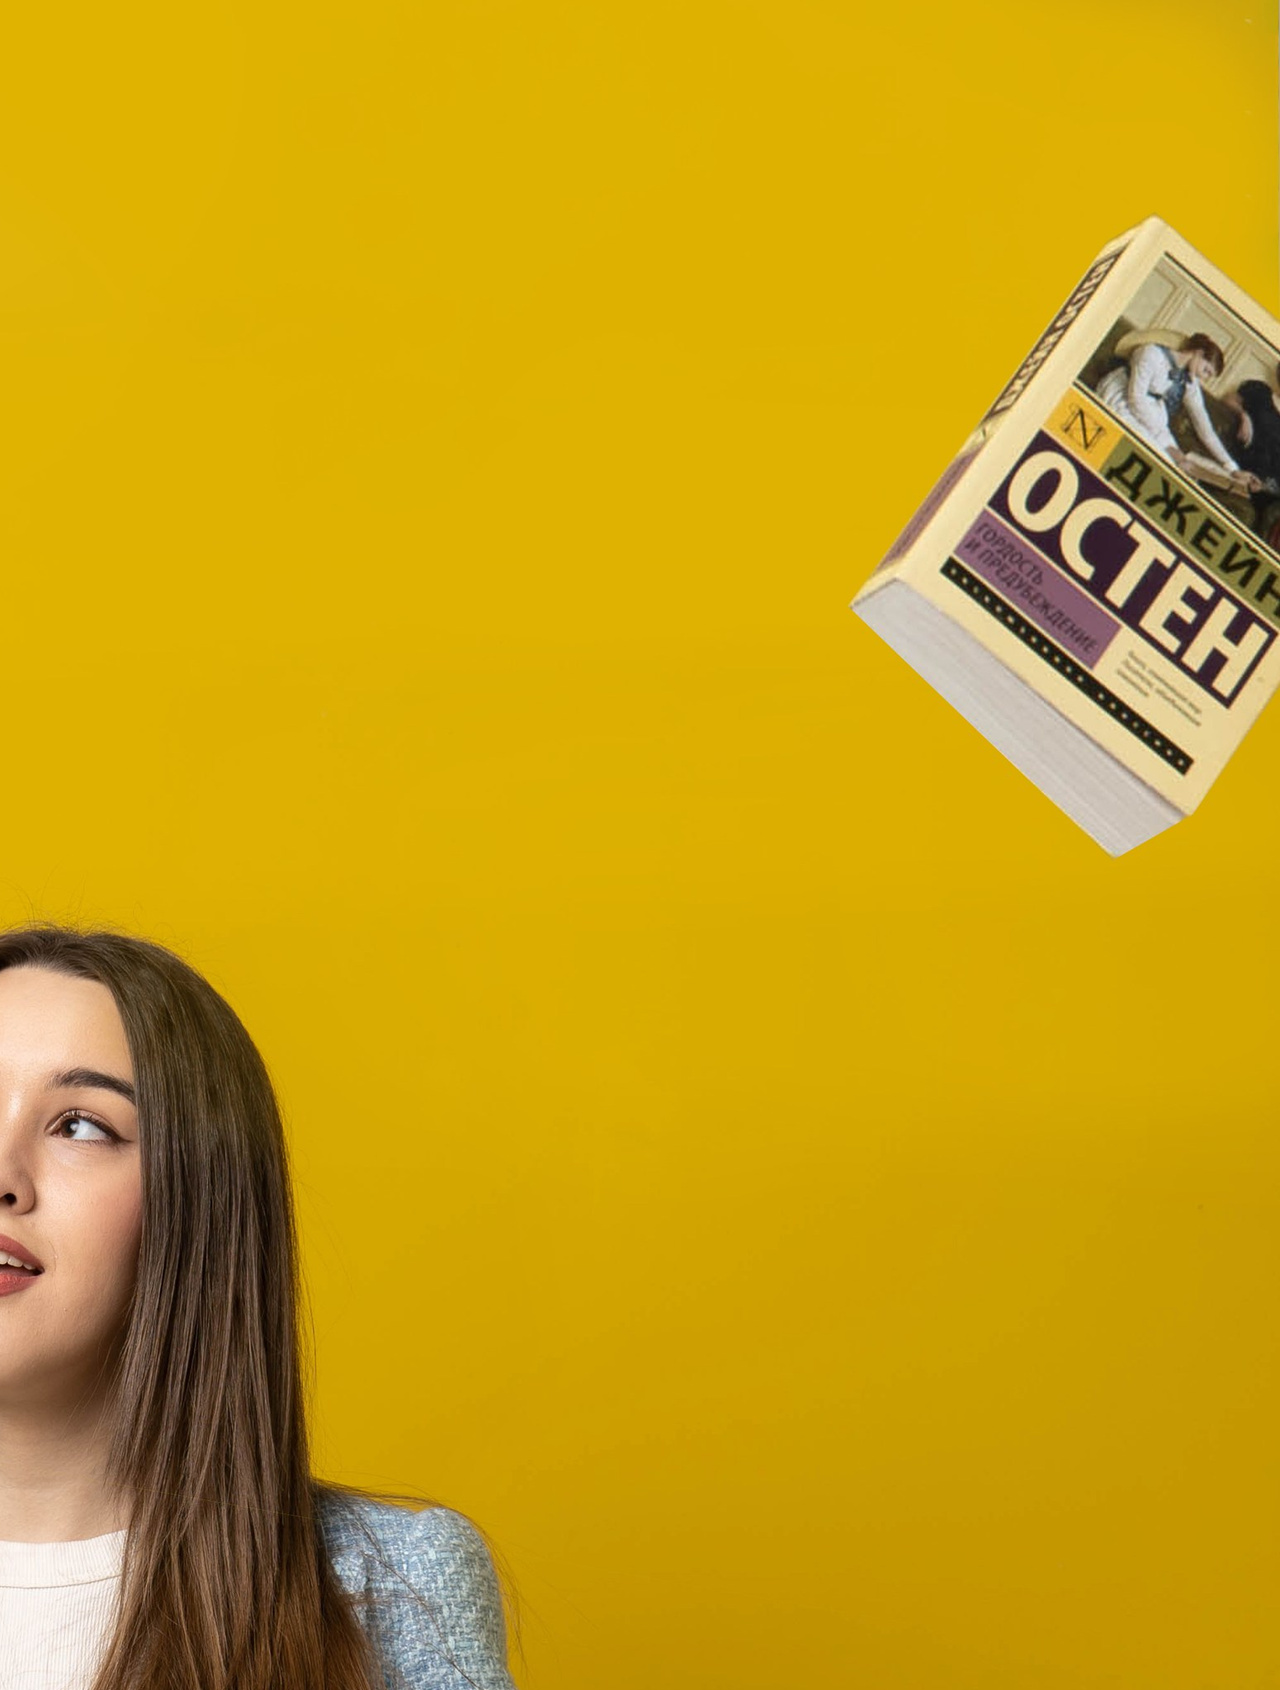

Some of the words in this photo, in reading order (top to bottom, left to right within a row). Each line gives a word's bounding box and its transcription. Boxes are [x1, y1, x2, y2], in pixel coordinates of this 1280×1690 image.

[964, 538, 979, 555] И
[978, 549, 1098, 655] ПРЕДУБЕЖДЕНИЕ
[975, 522, 1044, 586] ГОРДОСТЬ
[1008, 451, 1269, 699] ОСТЕН
